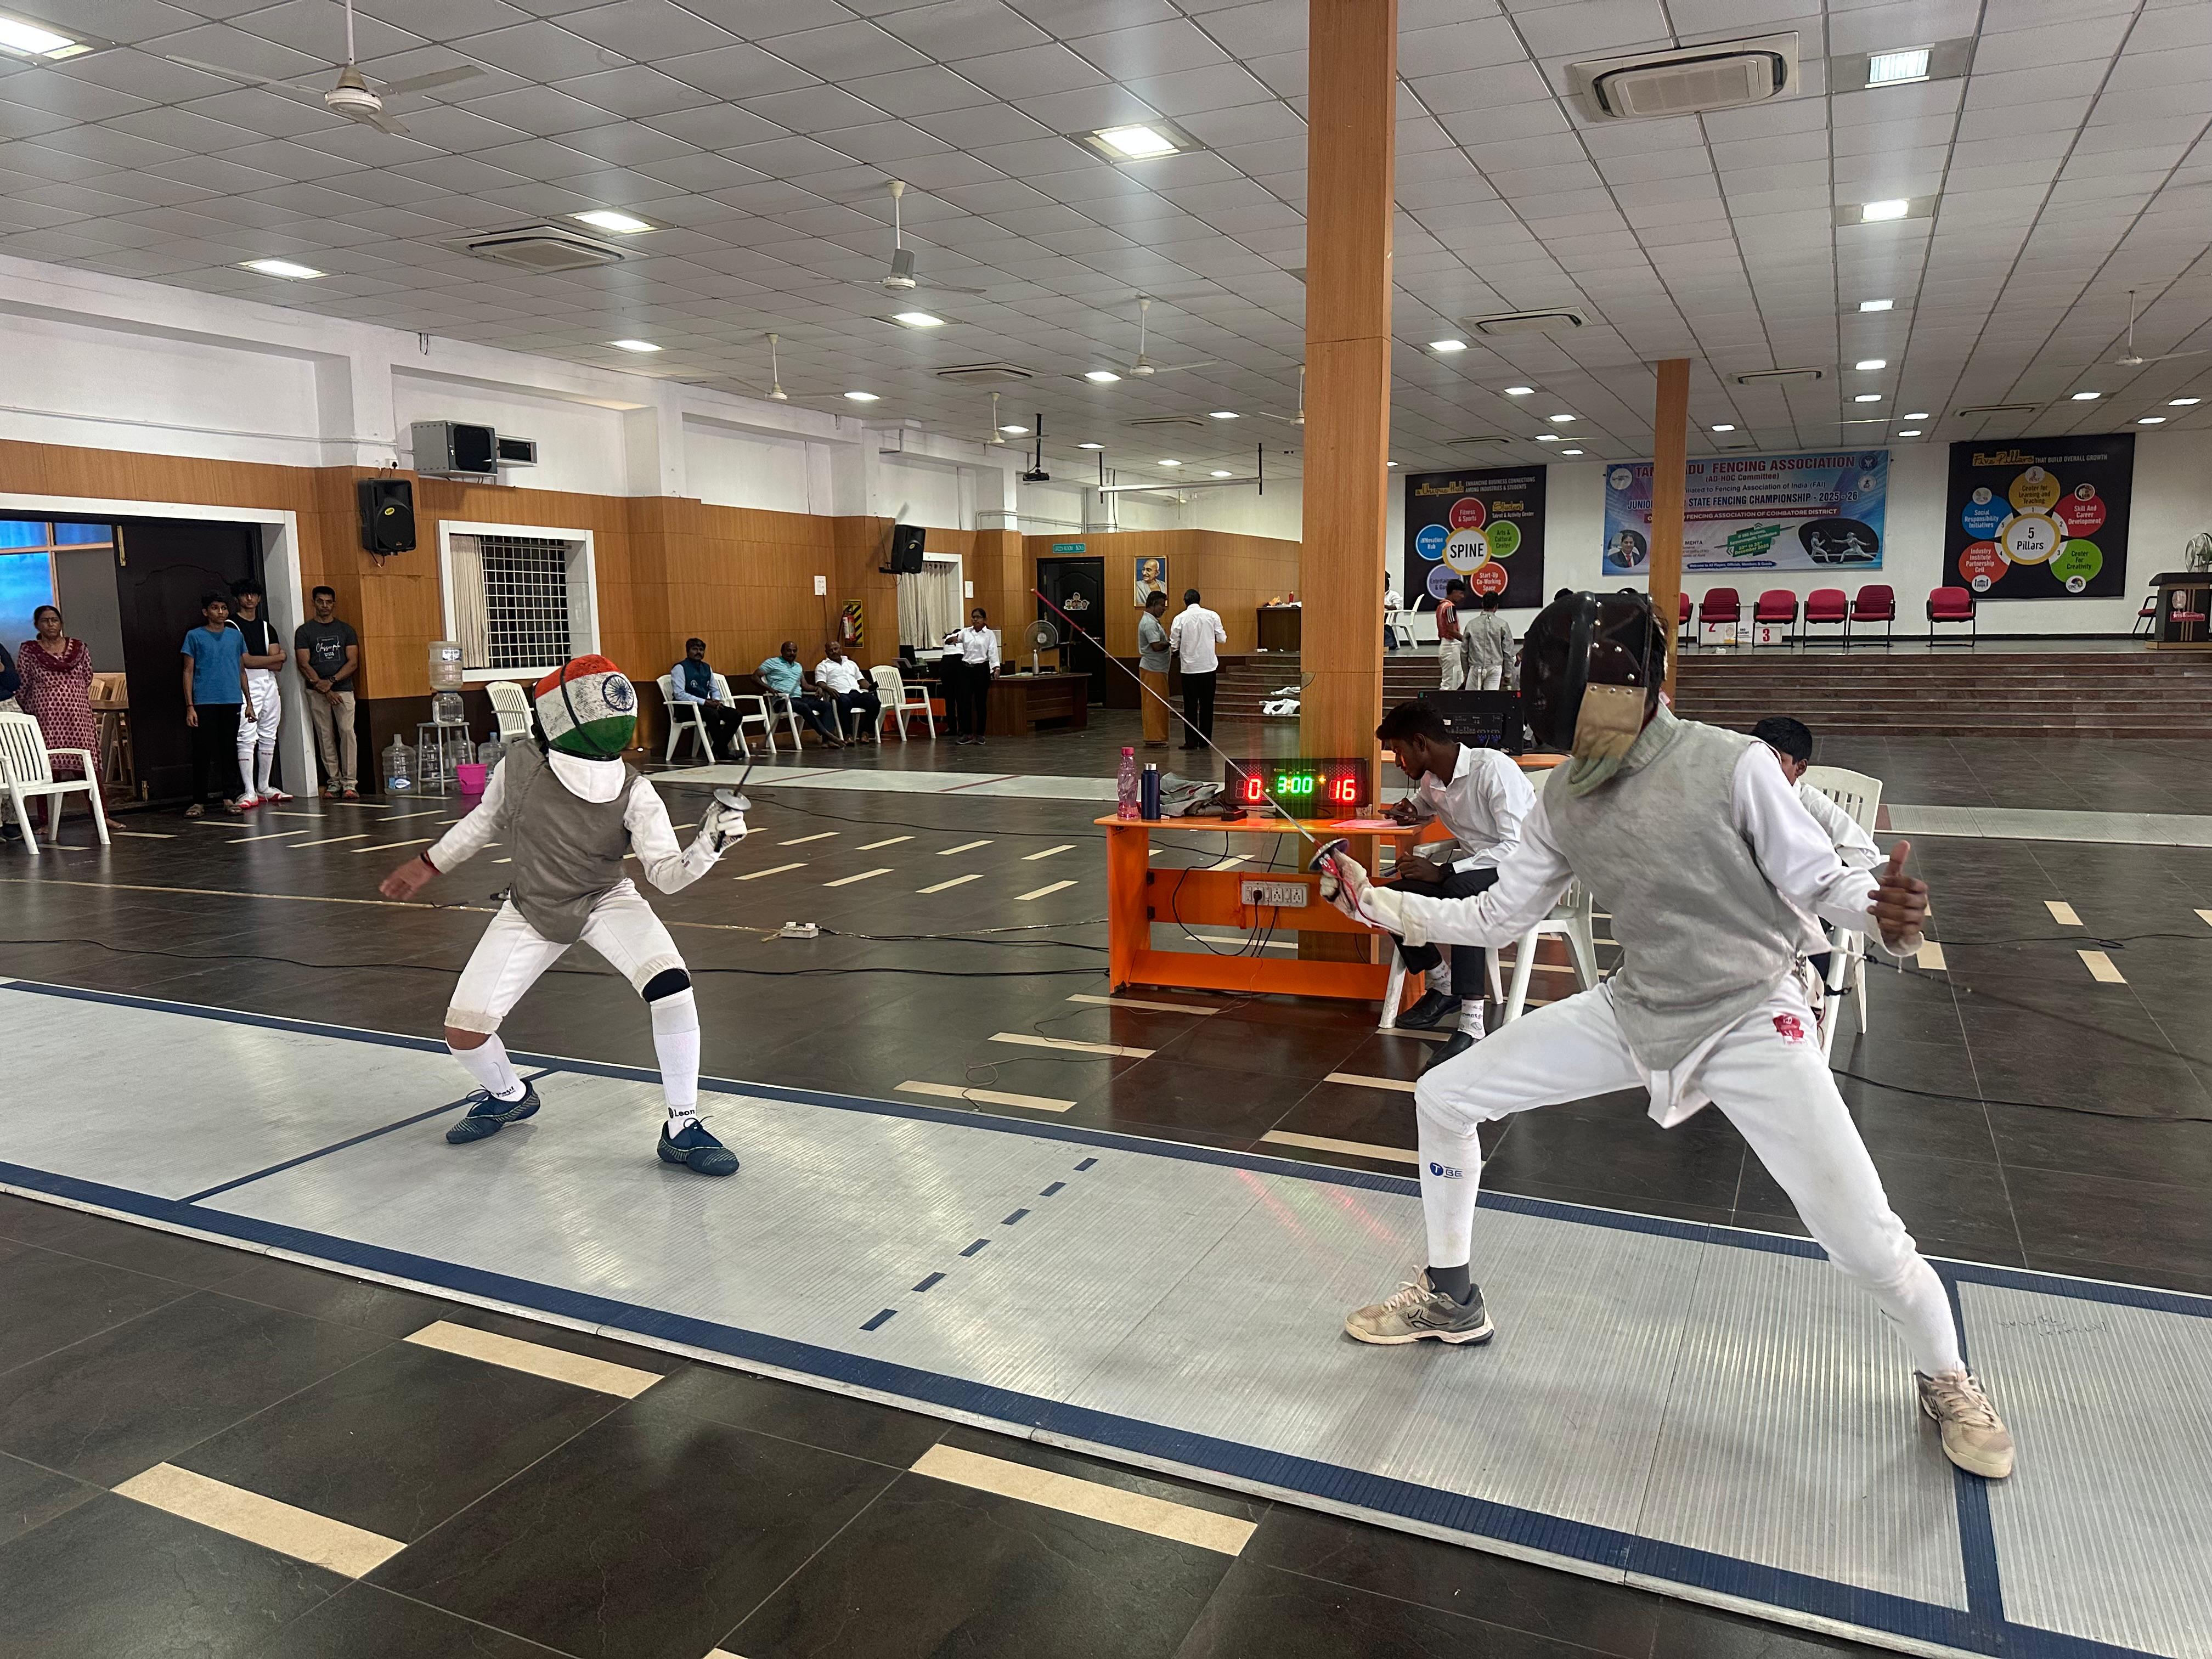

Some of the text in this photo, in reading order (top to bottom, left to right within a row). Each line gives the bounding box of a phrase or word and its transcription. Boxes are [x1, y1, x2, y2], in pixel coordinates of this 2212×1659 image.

[1973, 454, 1995, 465] Five
[1997, 450, 2034, 464] Pillars
[1685, 456, 1855, 475] DU FENCING ASSOCIATION
[1706, 473, 1779, 483] (AD-HOC Committee)
[1450, 481, 1464, 492] Hub
[1689, 497, 1711, 507] STATE
[1713, 495, 1747, 506] FENCING
[1749, 493, 1811, 504] CHAMPIONSHIP
[1819, 492, 1838, 501] 2025
[1848, 491, 1858, 500] 26
[2028, 527, 2035, 538] 5
[1449, 543, 1484, 558] SPINE
[2017, 540, 2044, 550] Pillars
[2067, 562, 2092, 571] Creativity
[1708, 623, 1716, 632] 2
[1763, 628, 1770, 641] 3
[1248, 776, 1355, 800] 0 3:00 16
[673, 1109, 695, 1117] Leon
